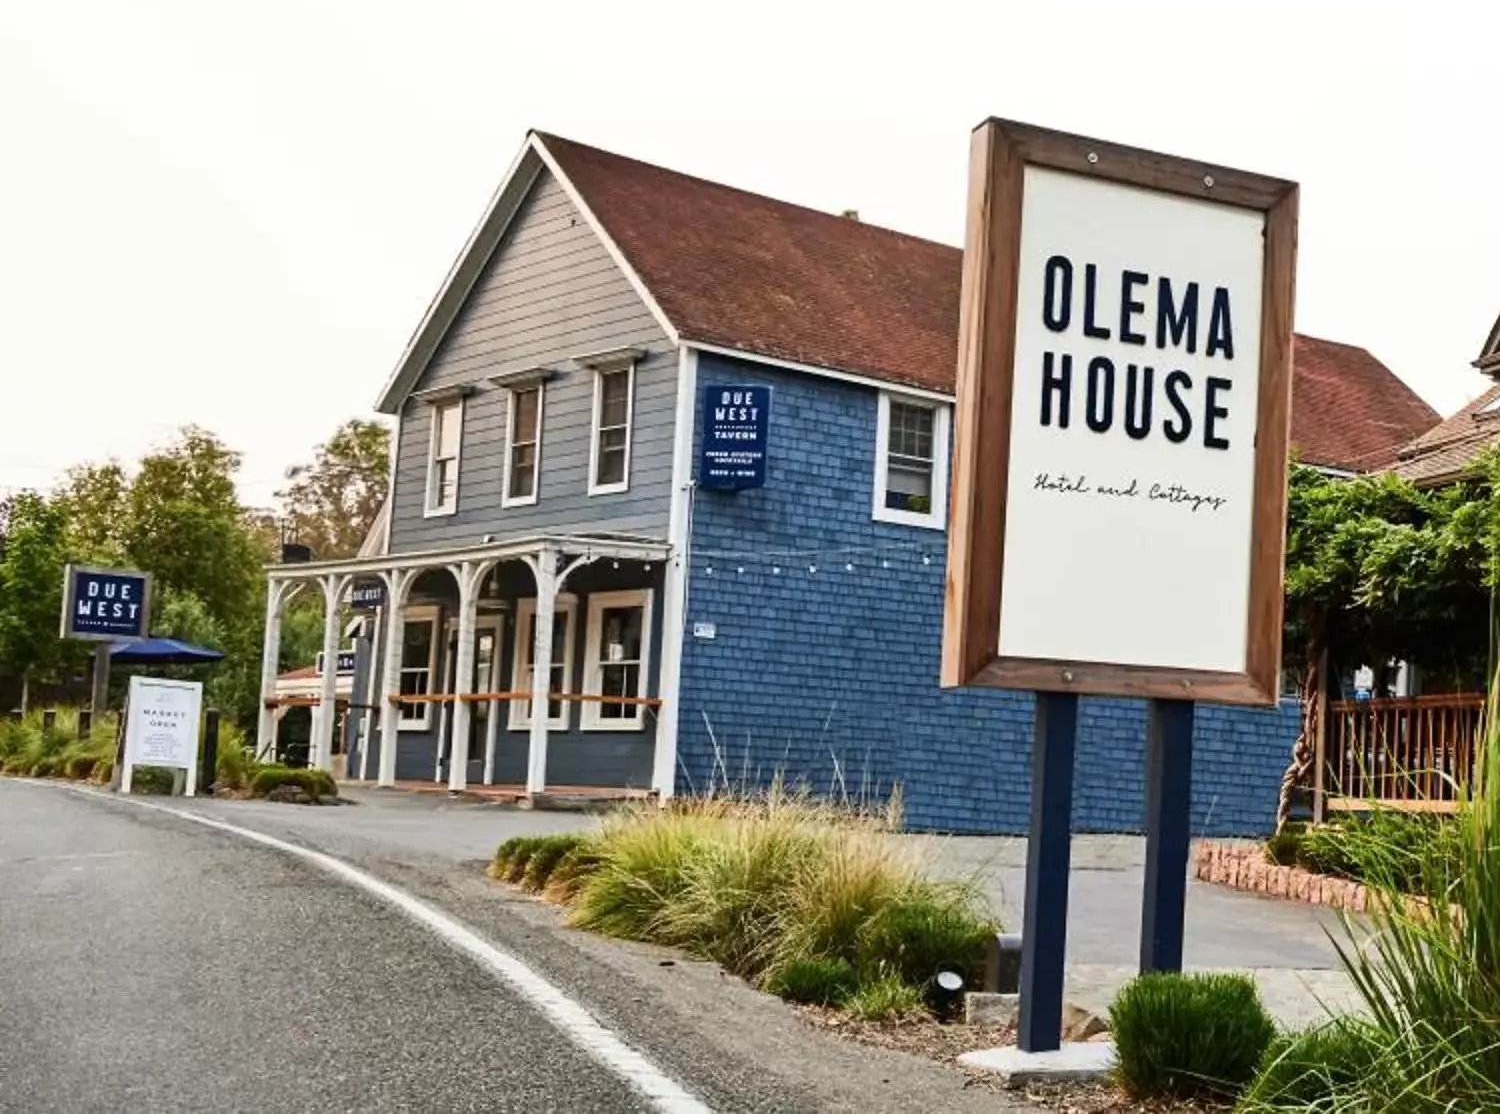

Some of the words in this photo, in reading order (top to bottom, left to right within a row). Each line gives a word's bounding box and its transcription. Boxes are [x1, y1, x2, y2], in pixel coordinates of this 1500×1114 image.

[1042, 254, 1235, 361] OLEMA
[720, 391, 754, 405] DUE
[1039, 351, 1232, 451] HOUSE
[714, 407, 759, 421] WEST
[713, 430, 758, 441] TAVERN
[1033, 472, 1090, 494] Hotel
[1096, 478, 1140, 498] and
[1148, 483, 1228, 512] Cottages
[87, 581, 132, 600] DUE
[77, 599, 139, 619] WEST
